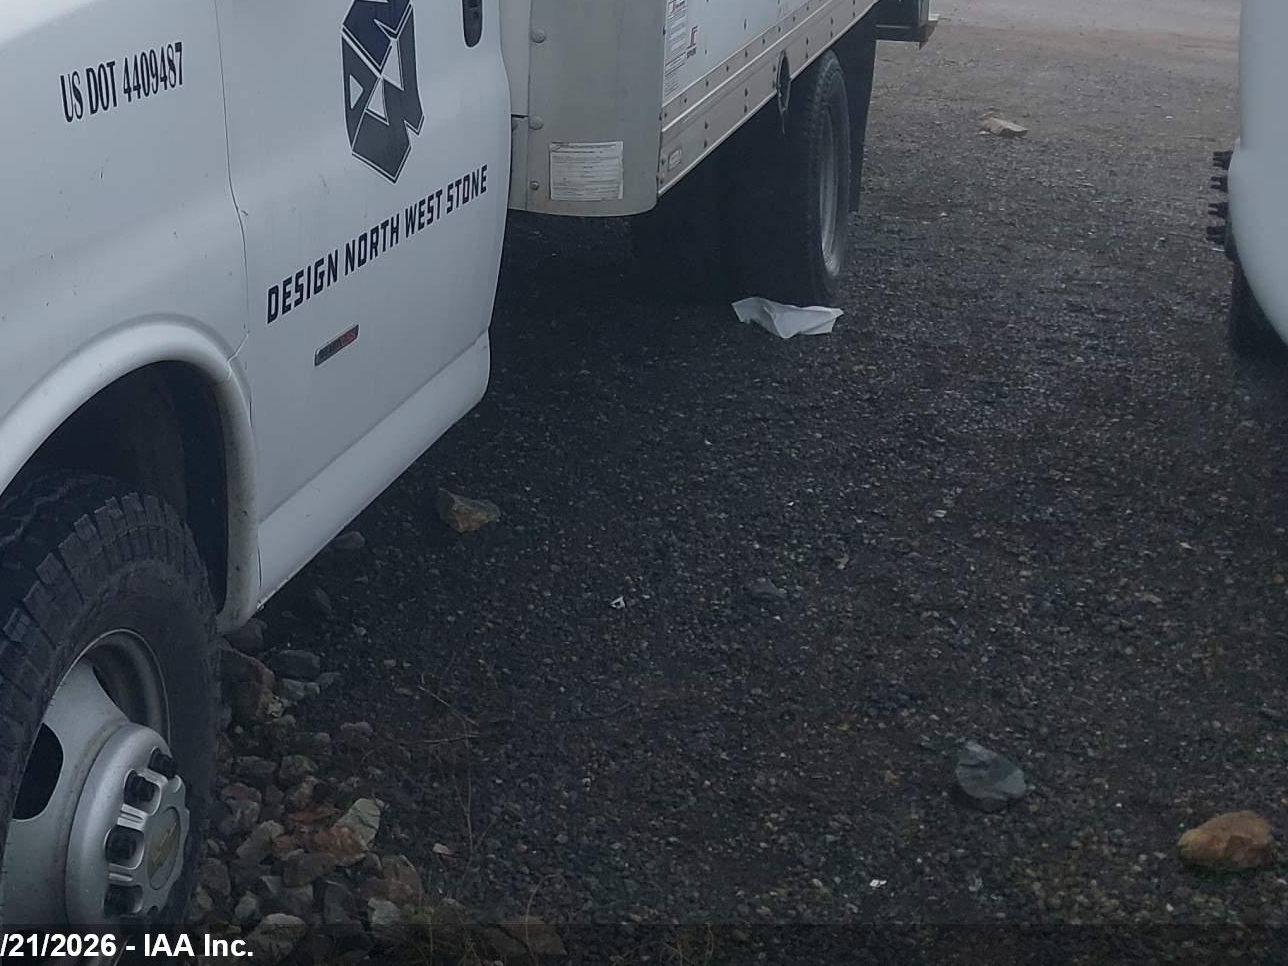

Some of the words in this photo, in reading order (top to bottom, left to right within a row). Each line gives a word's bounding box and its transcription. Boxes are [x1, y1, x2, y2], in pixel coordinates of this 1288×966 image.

[60, 71, 84, 122] US
[86, 61, 117, 115] DOT
[123, 42, 183, 102] 4409487
[267, 249, 339, 324] DESIGN
[344, 213, 400, 276] NORTH
[405, 189, 443, 238] WEST
[446, 164, 488, 214] STONE
